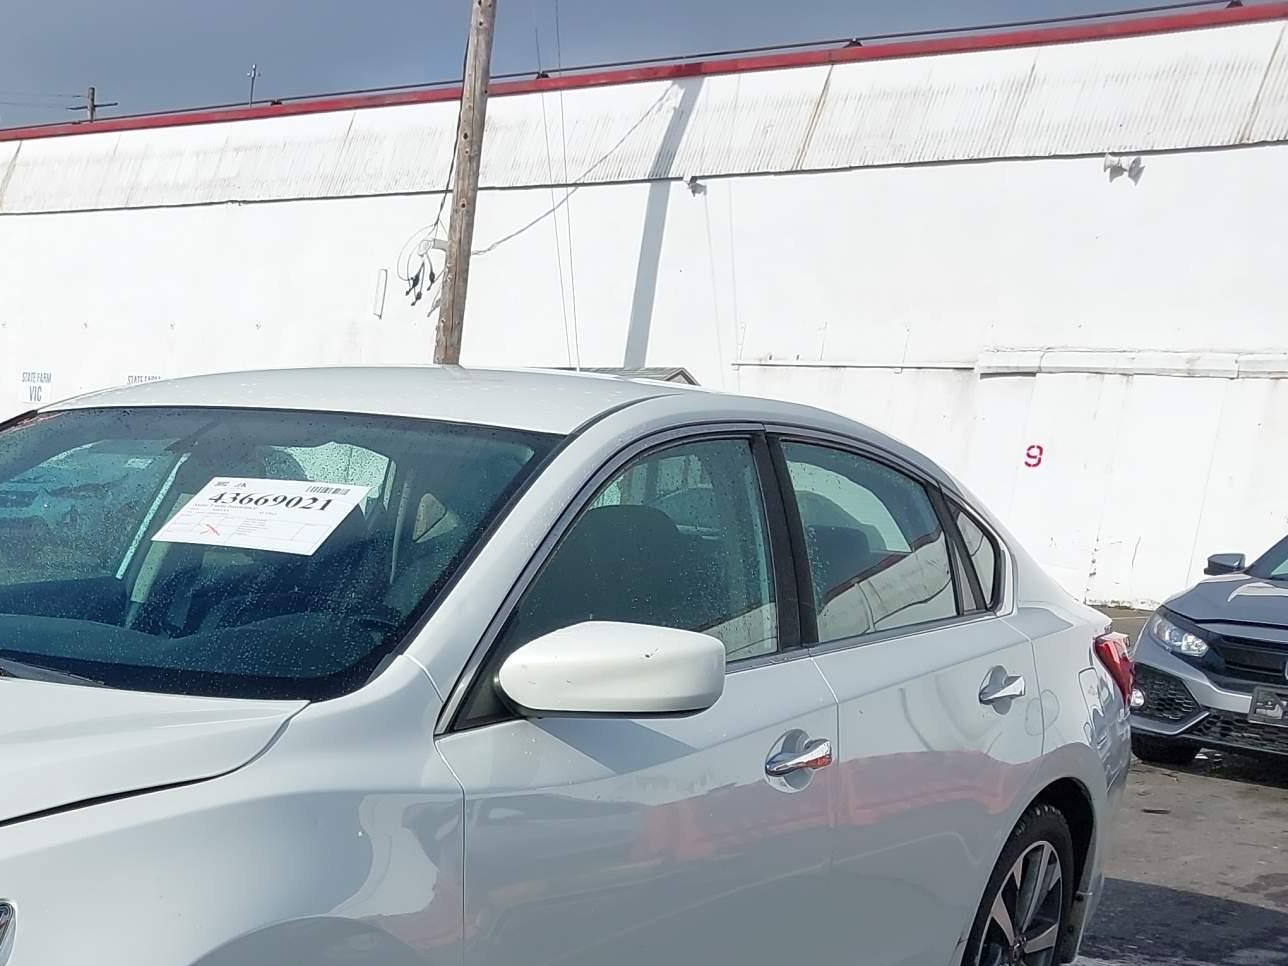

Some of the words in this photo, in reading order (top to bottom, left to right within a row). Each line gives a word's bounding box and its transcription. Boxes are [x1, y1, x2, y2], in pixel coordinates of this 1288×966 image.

[22, 371, 36, 383] STATE
[36, 371, 52, 383] FARM
[29, 385, 42, 402] VIC
[1024, 444, 1044, 468] 9
[208, 492, 332, 511] 43669021
